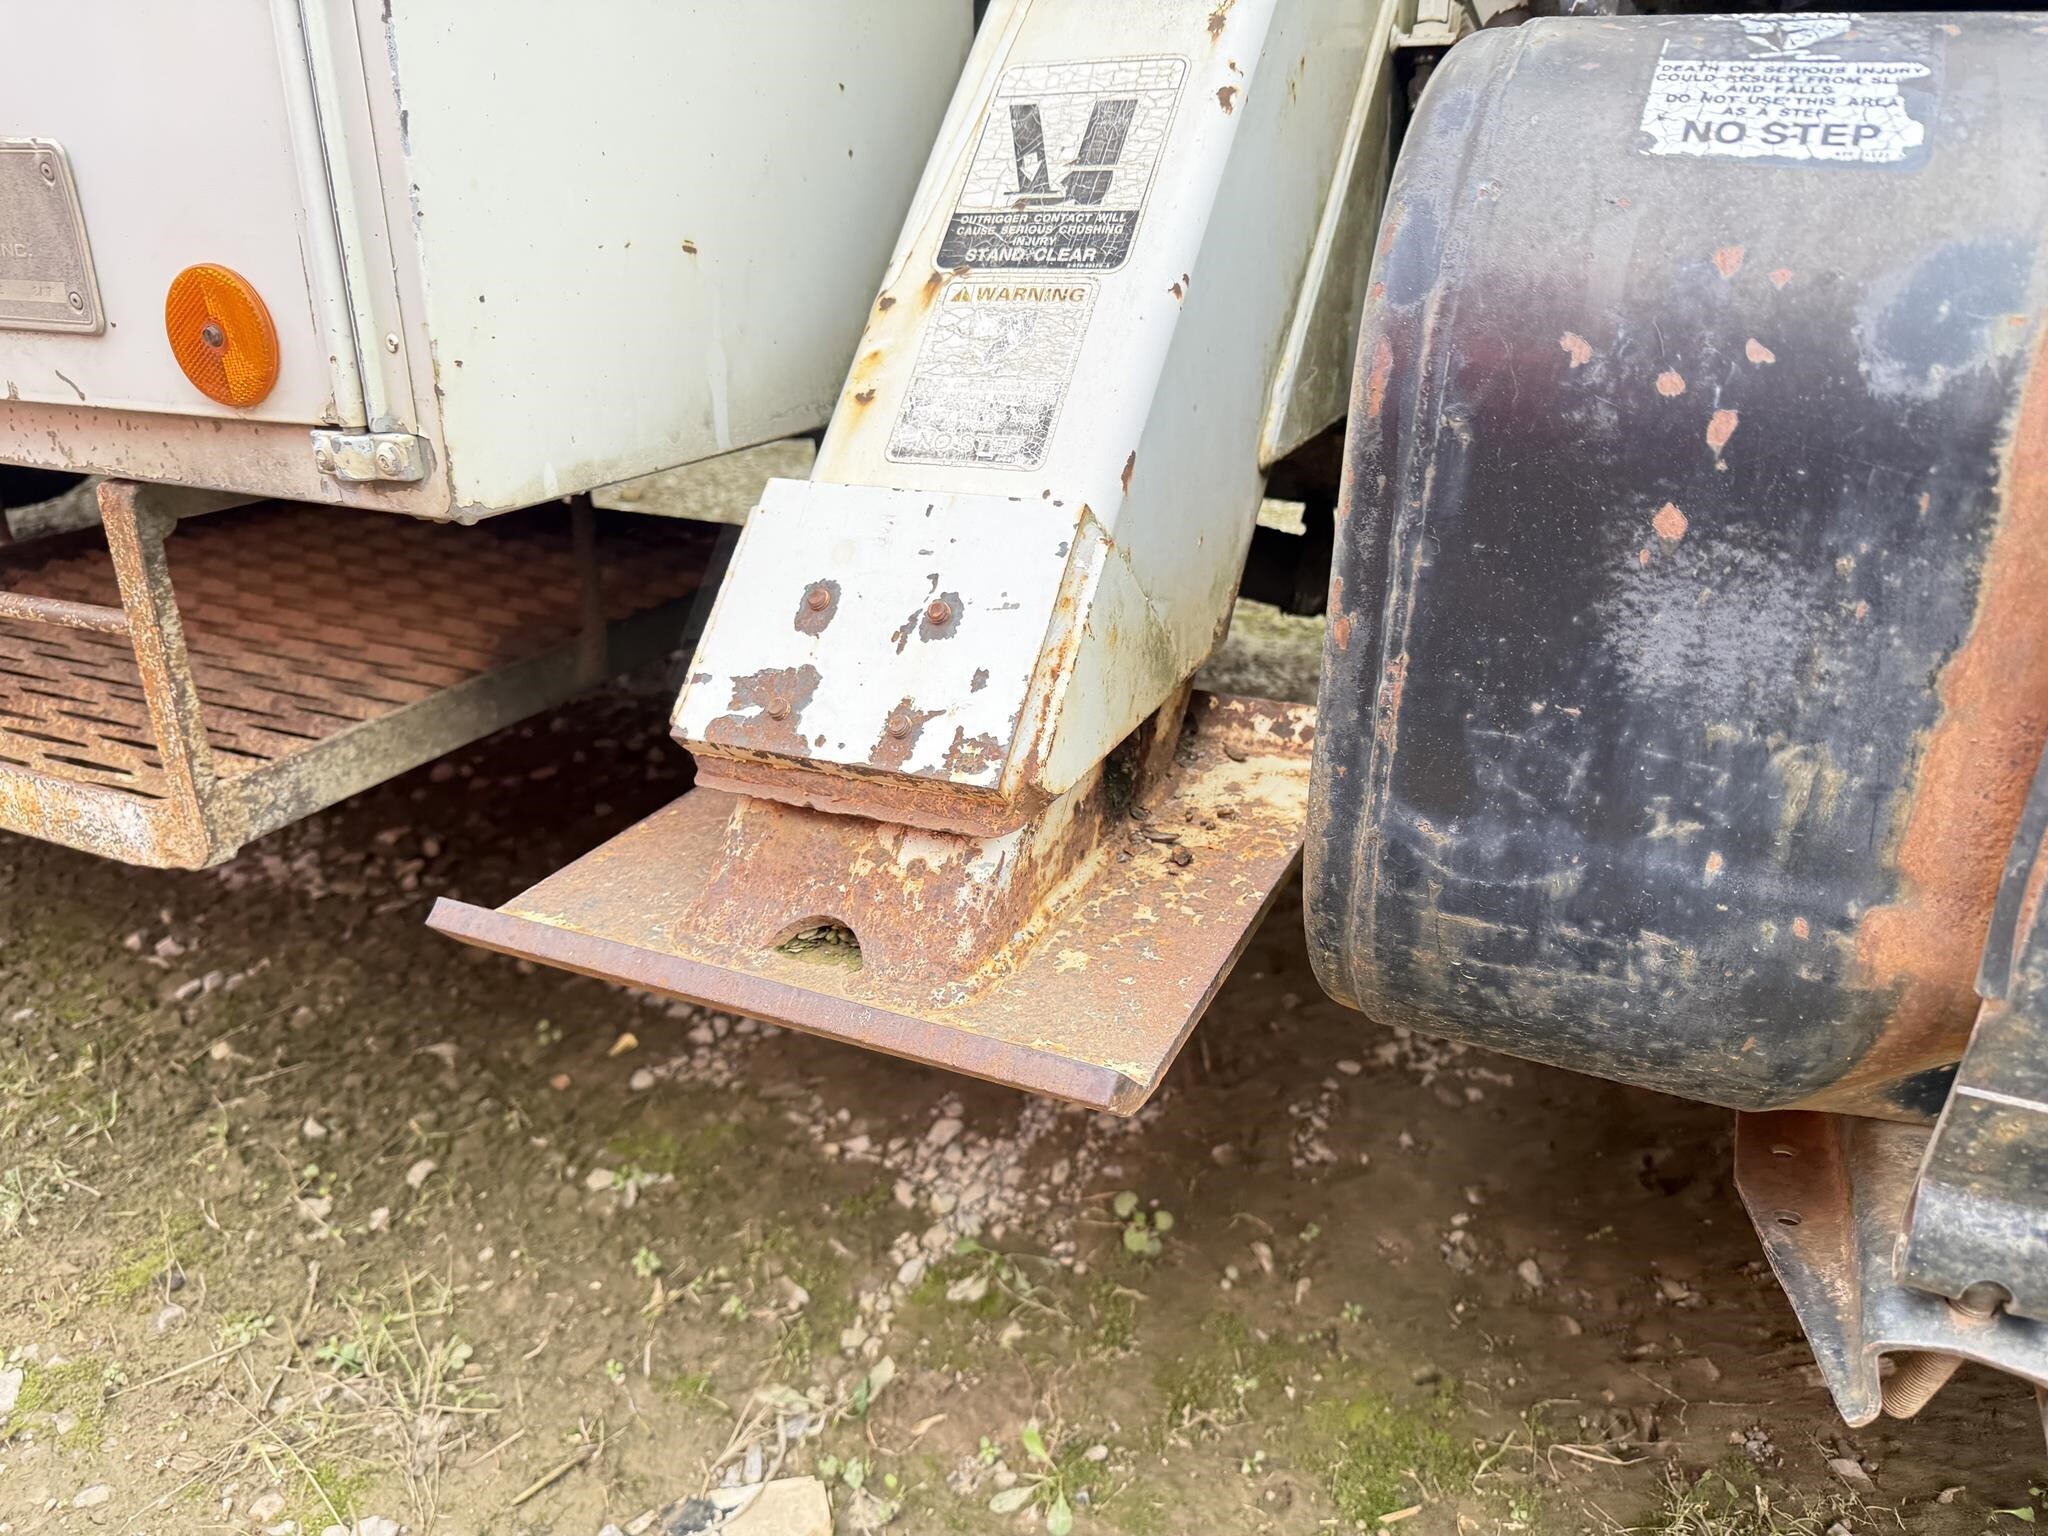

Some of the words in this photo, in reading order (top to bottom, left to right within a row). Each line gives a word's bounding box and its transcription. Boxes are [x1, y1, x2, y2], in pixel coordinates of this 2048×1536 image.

[1662, 64, 1719, 72] DEATH
[1764, 65, 1846, 74] SERIOUS
[1857, 66, 1924, 74] INJURY
[1656, 73, 1716, 82] COULD
[1726, 74, 1794, 84] RESULT
[1807, 75, 1861, 84] FROM
[1727, 85, 1764, 93] AND
[1775, 85, 1834, 94] FALLS
[1666, 94, 1691, 103] DO
[1700, 94, 1740, 104] NOT
[1748, 96, 1784, 105] USE
[1795, 97, 1836, 105] THIS
[1848, 97, 1899, 107] AREA
[1722, 107, 1746, 116] AS
[1757, 108, 1768, 116] A
[1779, 108, 1828, 118] STEP
[1682, 119, 1747, 144] NO
[1760, 121, 1882, 146] STEP
[959, 214, 1028, 224] OUTRIGGER
[1034, 213, 1092, 223] CONTACT
[1096, 213, 1127, 223] WILL
[956, 226, 995, 235] CAUSE
[1001, 225, 1054, 235] SERIOUS
[1059, 224, 1124, 235] CRUSHING
[1011, 236, 1058, 246] INJURY
[0, 243, 33, 257] NC.
[965, 247, 1024, 262] STAND
[1034, 247, 1097, 262] CLEAR
[977, 287, 1086, 302] WARNING
